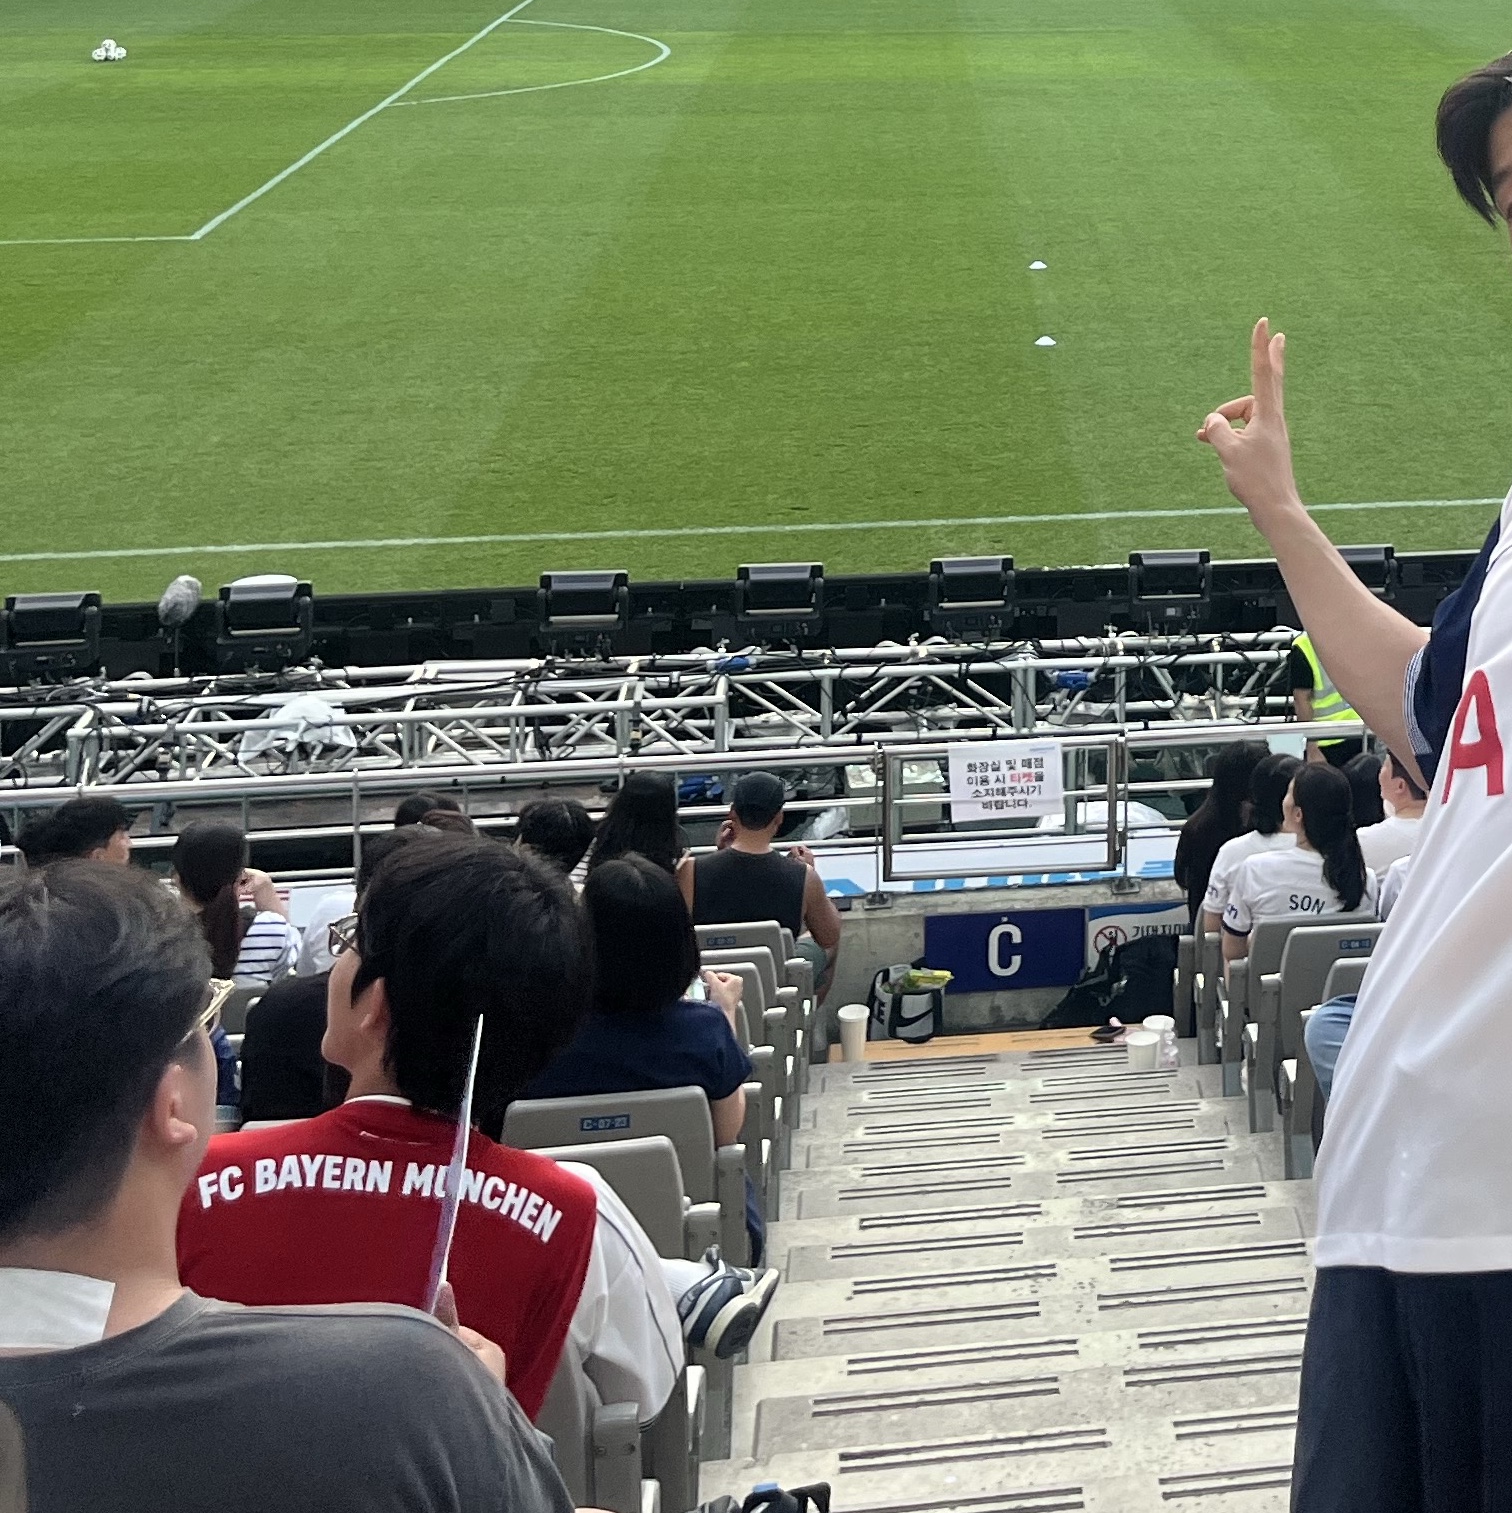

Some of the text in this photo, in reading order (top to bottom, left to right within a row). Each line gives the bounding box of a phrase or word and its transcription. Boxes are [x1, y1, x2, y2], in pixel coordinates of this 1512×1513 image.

[966, 757, 1044, 772] 화장실 및 매점
[966, 774, 990, 786] 이용
[994, 774, 1006, 784] 시
[971, 785, 1042, 798] 소지해주시기
[1289, 894, 1326, 915] SON
[988, 923, 1022, 977] C
[198, 1165, 245, 1209] FC
[254, 1153, 393, 1195] BAYERN
